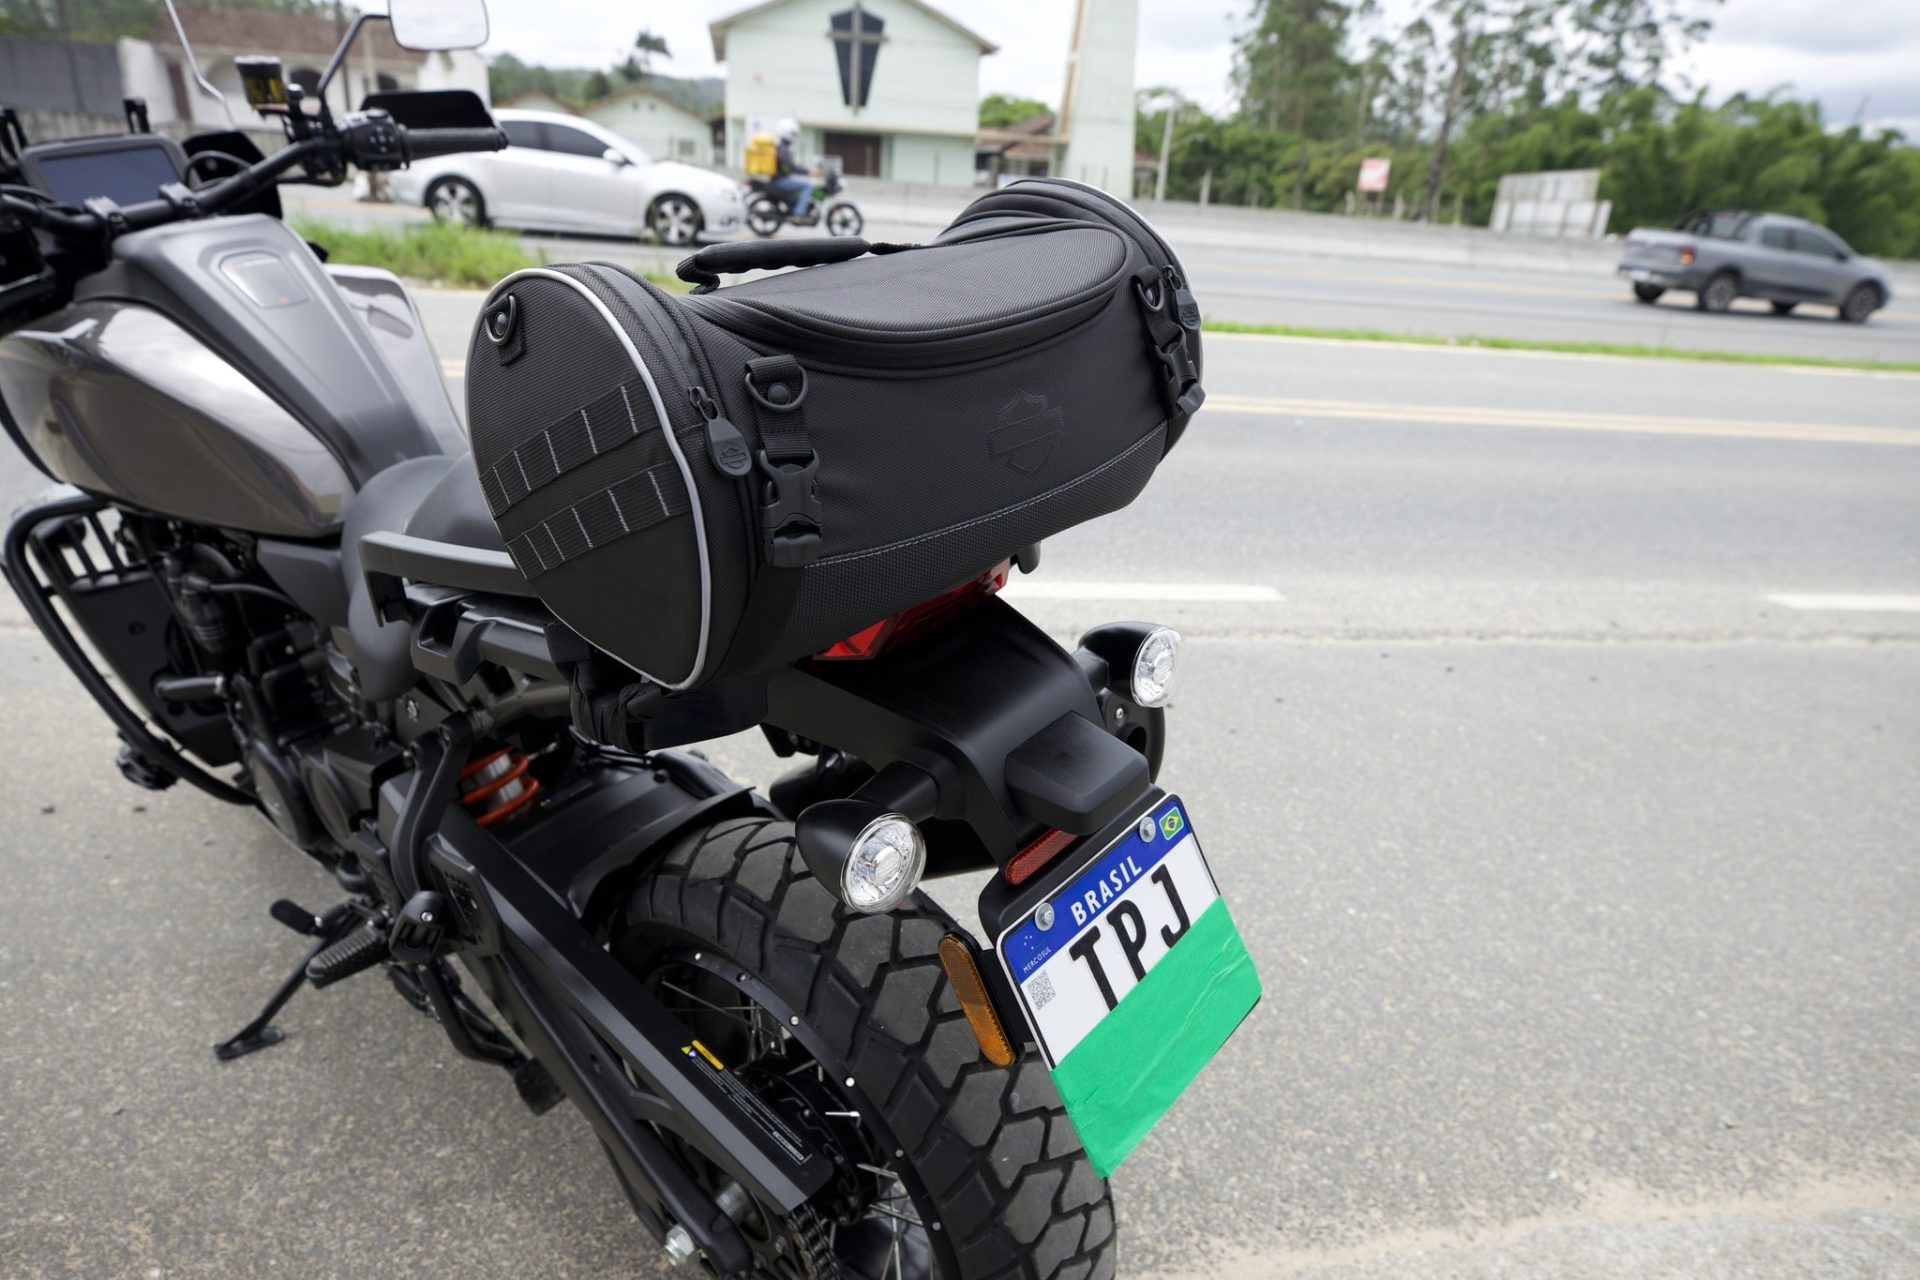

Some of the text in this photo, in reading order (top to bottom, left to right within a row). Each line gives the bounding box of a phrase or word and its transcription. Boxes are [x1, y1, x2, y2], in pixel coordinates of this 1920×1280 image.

[1070, 856, 1143, 926] BRASIL
[1023, 946, 1052, 973] MERCOSUL
[1069, 863, 1191, 1012] TPJ
